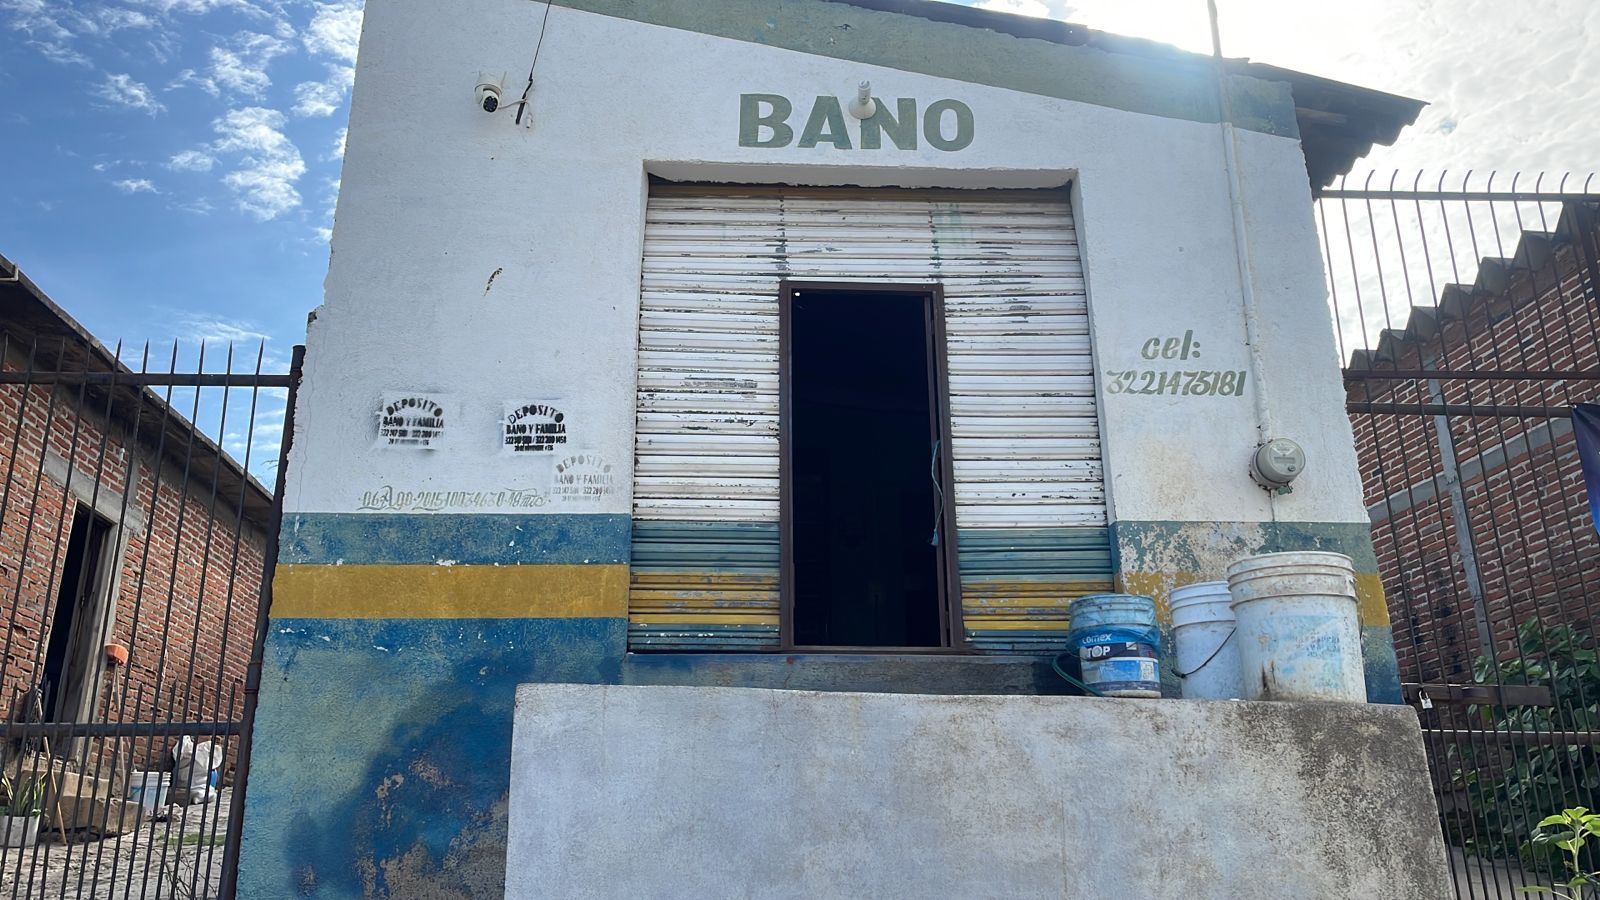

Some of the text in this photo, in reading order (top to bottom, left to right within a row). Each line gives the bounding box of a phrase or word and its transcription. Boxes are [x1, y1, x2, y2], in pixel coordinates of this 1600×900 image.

[738, 93, 975, 152] BANO
[1141, 329, 1201, 361] cel:
[1106, 370, 1247, 397] 3221475181
[386, 398, 443, 417] DEPOSITO
[507, 404, 564, 424] DEPOSITO
[506, 423, 566, 434] BANO Y FAMILIA
[1084, 645, 1112, 658] TOP
